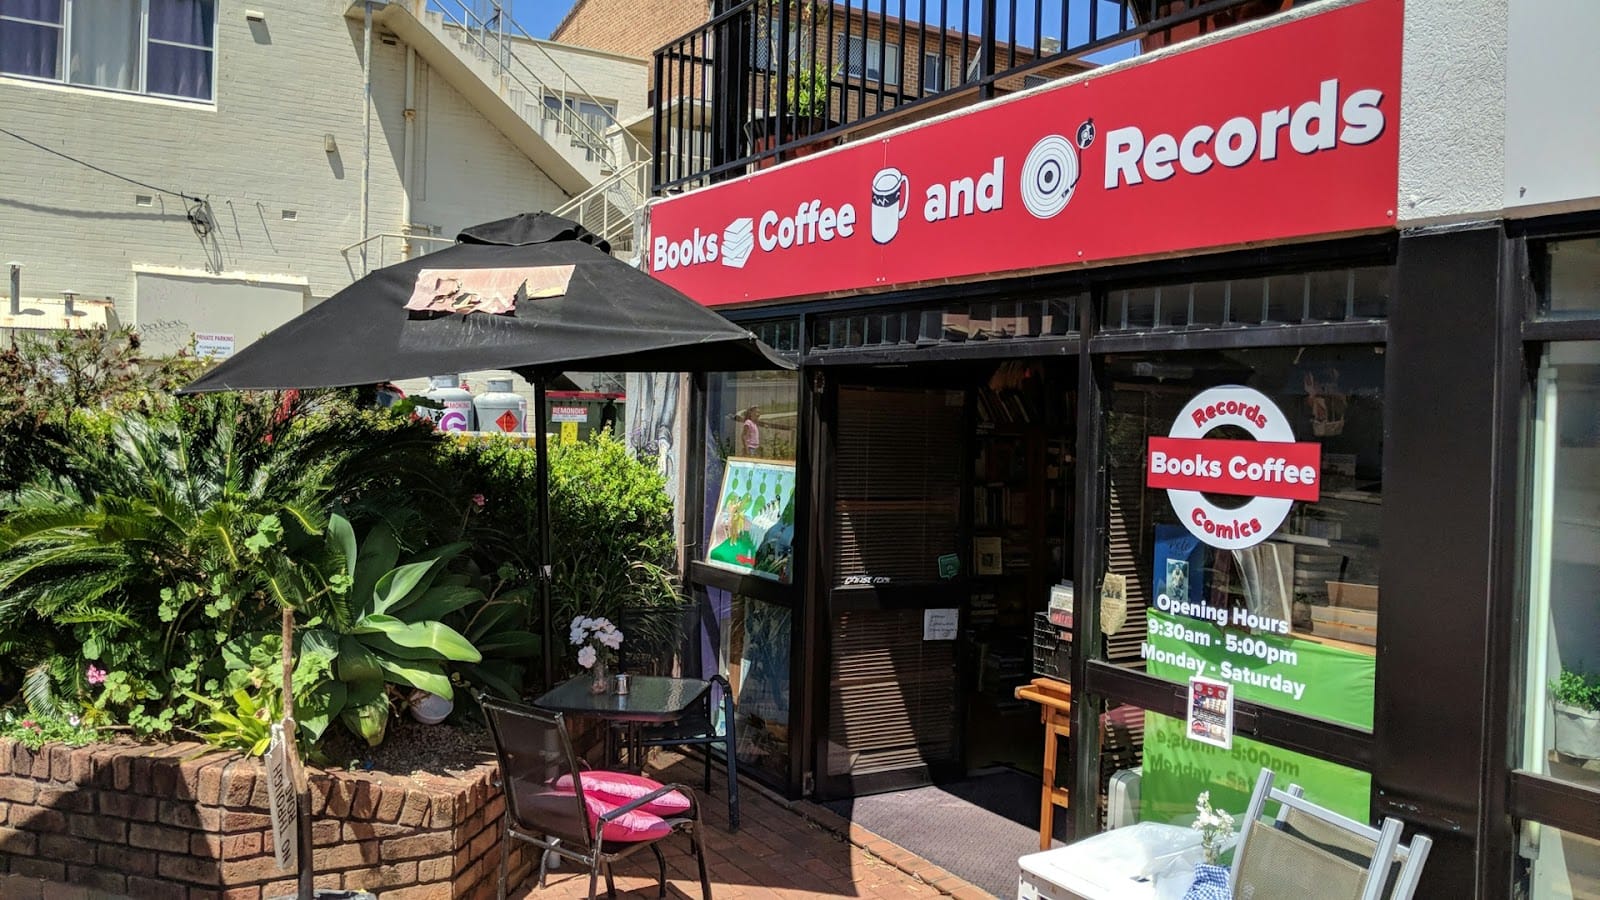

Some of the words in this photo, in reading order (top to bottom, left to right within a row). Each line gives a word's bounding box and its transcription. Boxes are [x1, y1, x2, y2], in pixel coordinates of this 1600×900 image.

[653, 228, 719, 272] Books
[758, 199, 857, 253] Coffee
[924, 156, 1005, 223] and
[1104, 78, 1386, 190] Records
[1191, 400, 1268, 430] Records
[1151, 451, 1222, 478] Books
[1228, 456, 1316, 485] Coffee
[1191, 507, 1263, 540] Comics
[1156, 593, 1228, 627] Opening
[1233, 606, 1290, 634] Hours
[1148, 618, 1211, 647] 9:30am
[1225, 633, 1298, 667] 5:00pm
[1140, 642, 1207, 677] Monday
[1220, 660, 1306, 700] Saturday
[273, 764, 287, 838] THROUGH
[281, 838, 292, 864] NO
